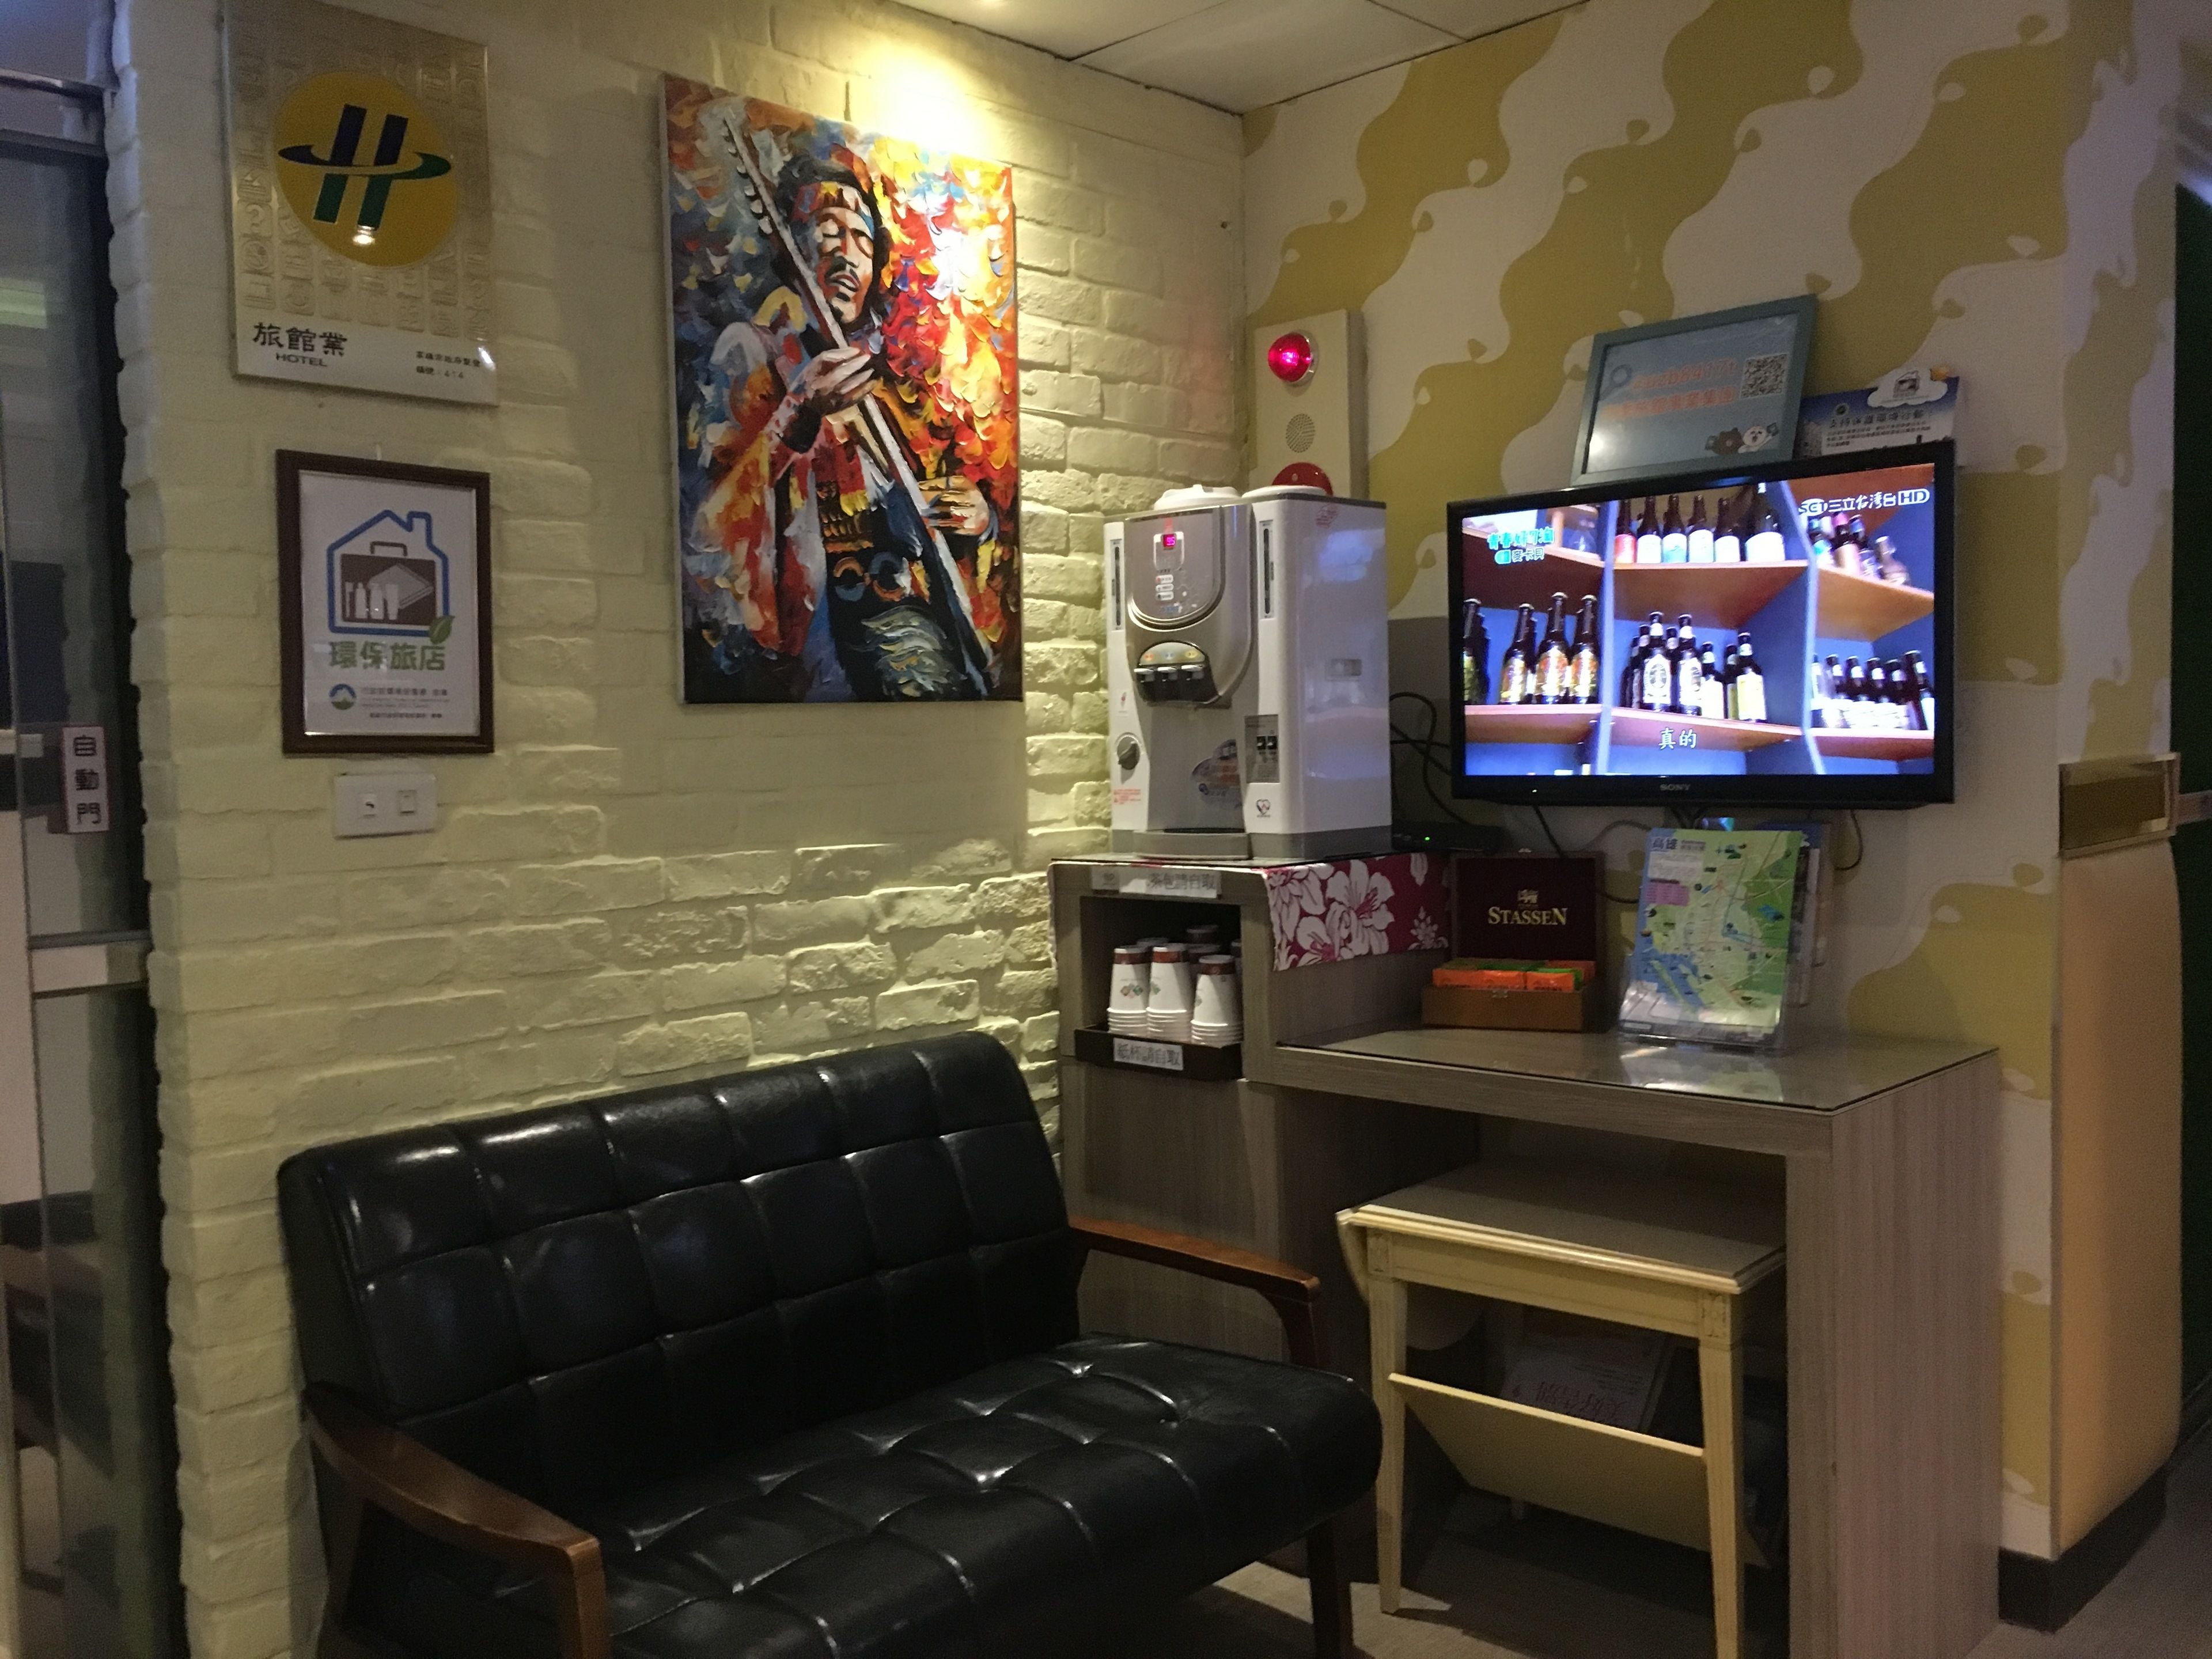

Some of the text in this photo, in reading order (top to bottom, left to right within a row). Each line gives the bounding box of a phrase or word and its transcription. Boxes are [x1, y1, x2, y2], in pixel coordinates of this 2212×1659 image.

[252, 322, 348, 358] 旅館業
[275, 353, 327, 366] HOTEL
[1899, 489, 1929, 505] HD
[328, 640, 445, 671] 環保旅店
[1658, 727, 1697, 749] 真的
[73, 734, 102, 825] 自動門
[1488, 906, 1568, 925] STASSEN
